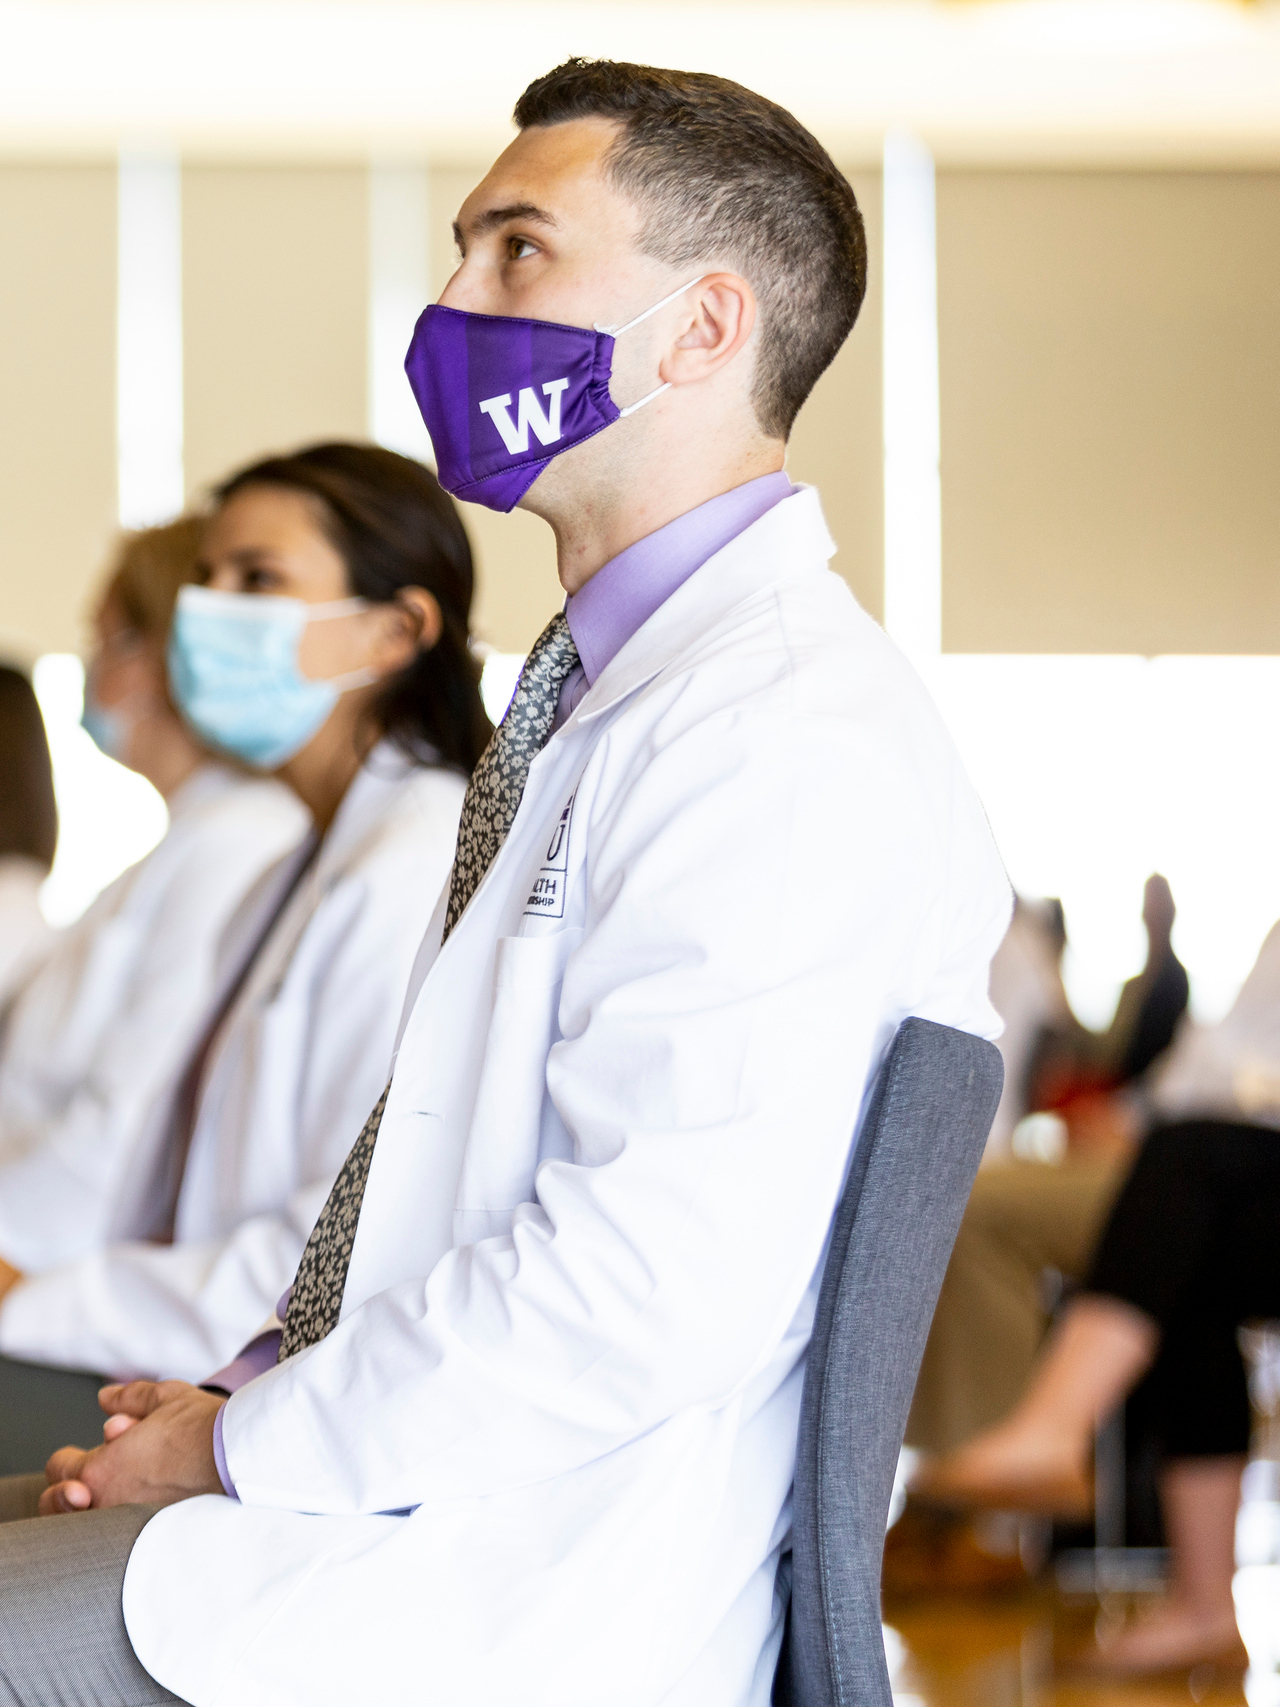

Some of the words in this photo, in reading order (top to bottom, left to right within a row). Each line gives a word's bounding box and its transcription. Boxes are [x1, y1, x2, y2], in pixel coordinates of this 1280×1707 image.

[479, 377, 569, 455] W
[532, 878, 556, 894] LTH
[527, 895, 555, 906] SHIP
